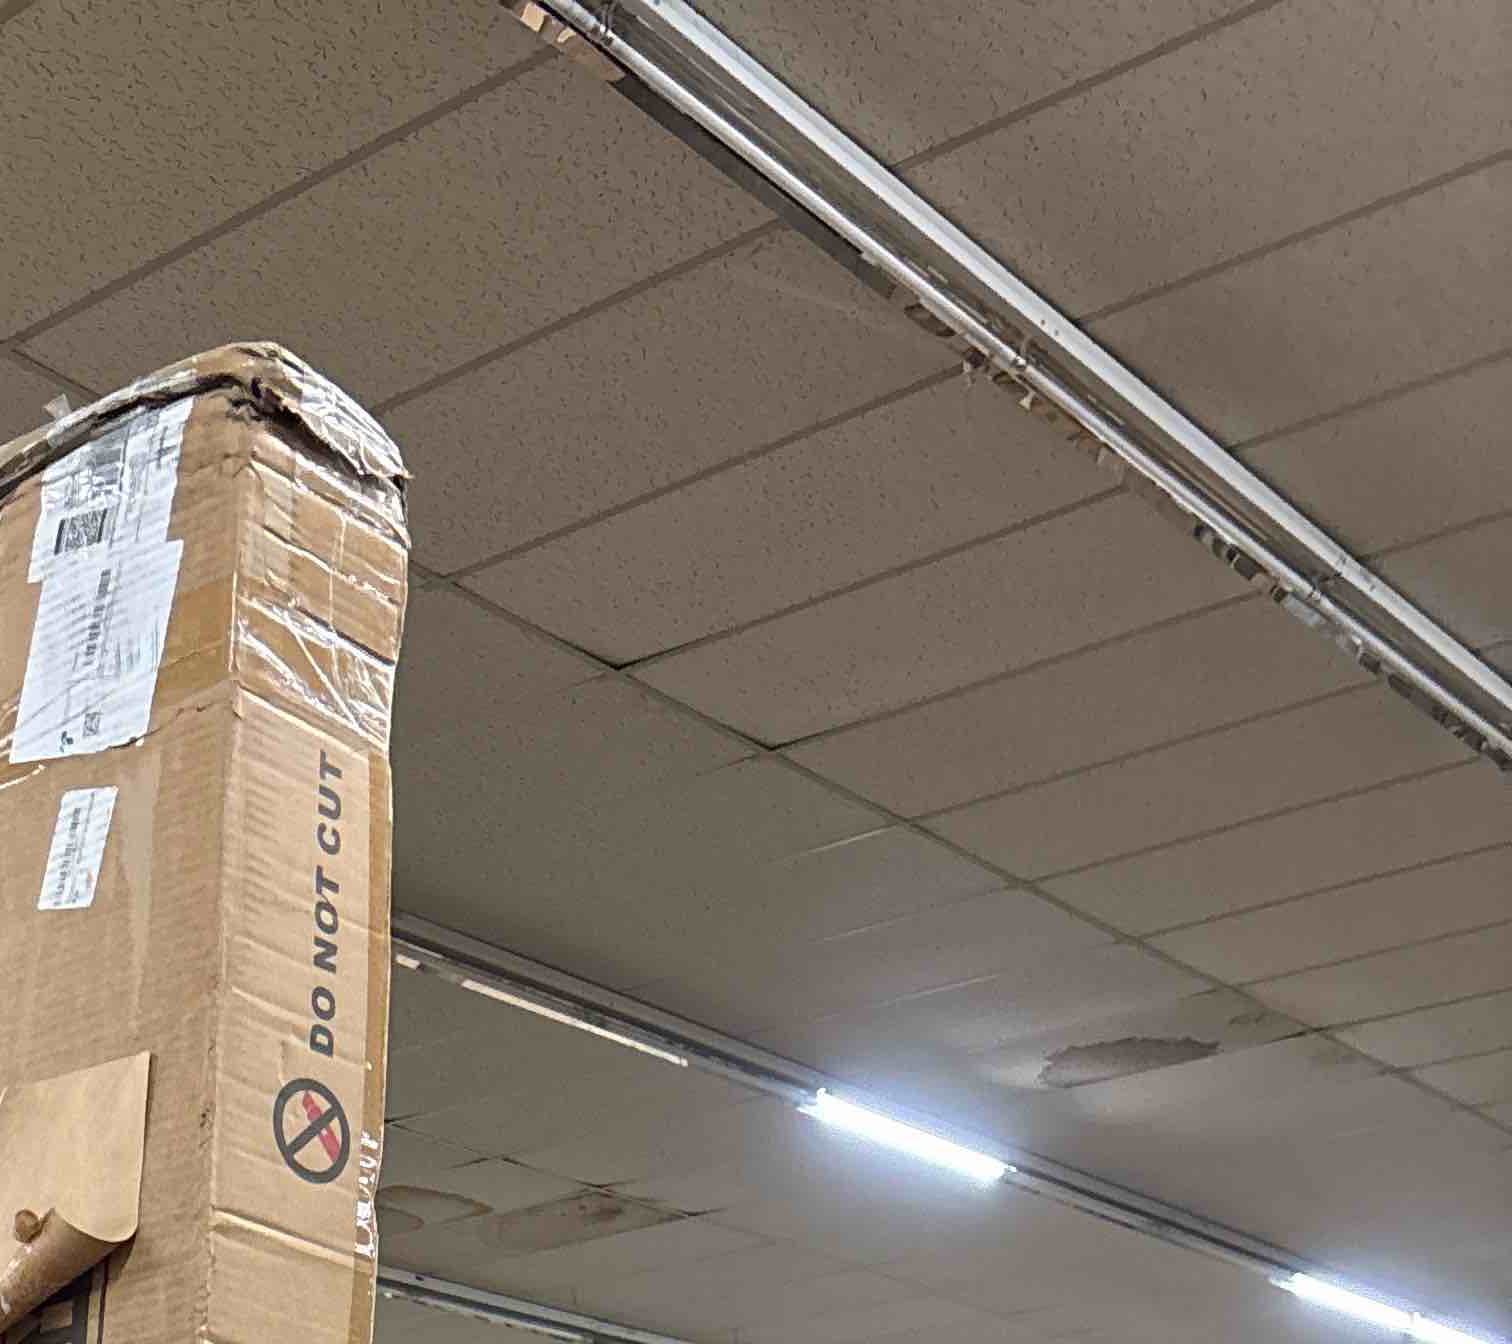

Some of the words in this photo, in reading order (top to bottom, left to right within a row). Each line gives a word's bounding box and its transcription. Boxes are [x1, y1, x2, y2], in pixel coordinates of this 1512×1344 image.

[316, 749, 344, 856] CUT
[312, 864, 340, 975] NOT
[309, 985, 337, 1058] DO
